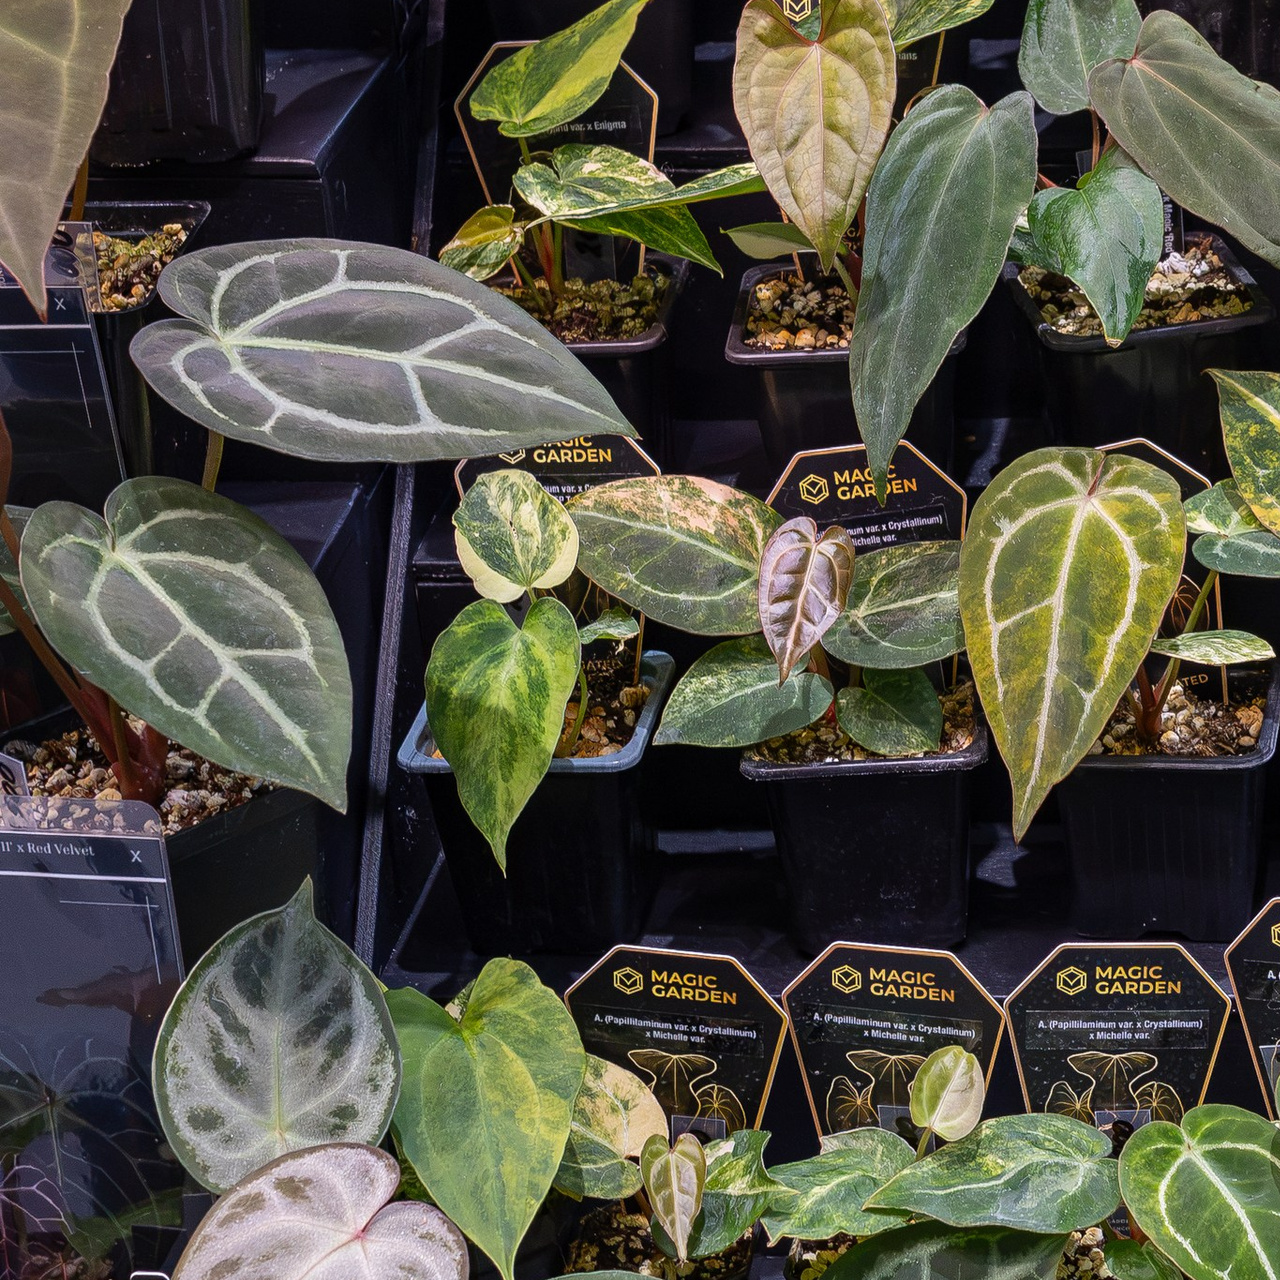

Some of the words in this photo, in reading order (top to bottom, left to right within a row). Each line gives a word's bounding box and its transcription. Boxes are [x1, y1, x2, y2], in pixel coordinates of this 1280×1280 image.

[594, 120, 627, 131] Enigma
[533, 449, 612, 463] GARDEN
[834, 465, 897, 485] MAGC
[888, 514, 943, 531] Crystallinum)
[17, 844, 24, 853] x
[27, 842, 51, 854] Red
[54, 843, 95, 856] Velvet
[652, 970, 717, 988] MAGIC
[870, 967, 935, 986] MAGIC
[1095, 966, 1163, 979] MAGIC
[1267, 970, 1276, 979] A.
[652, 985, 737, 1005] GARDEN
[870, 983, 955, 1003] GARDEN
[1095, 981, 1181, 995] GARDEN
[594, 1014, 603, 1023] A.
[674, 1024, 690, 1032] var.
[699, 1025, 757, 1039] Crystallinum)
[813, 1012, 822, 1021] A.
[918, 1024, 976, 1039] Crystallinum)
[1038, 1020, 1047, 1029] A.
[1118, 1021, 1134, 1029] var.
[1144, 1019, 1203, 1030] Crystallinum)
[653, 1030, 688, 1041] Michelle
[690, 1035, 706, 1043] var.
[871, 1029, 907, 1041] Michelle
[909, 1035, 925, 1043] var.
[1097, 1031, 1132, 1040] Michelle
